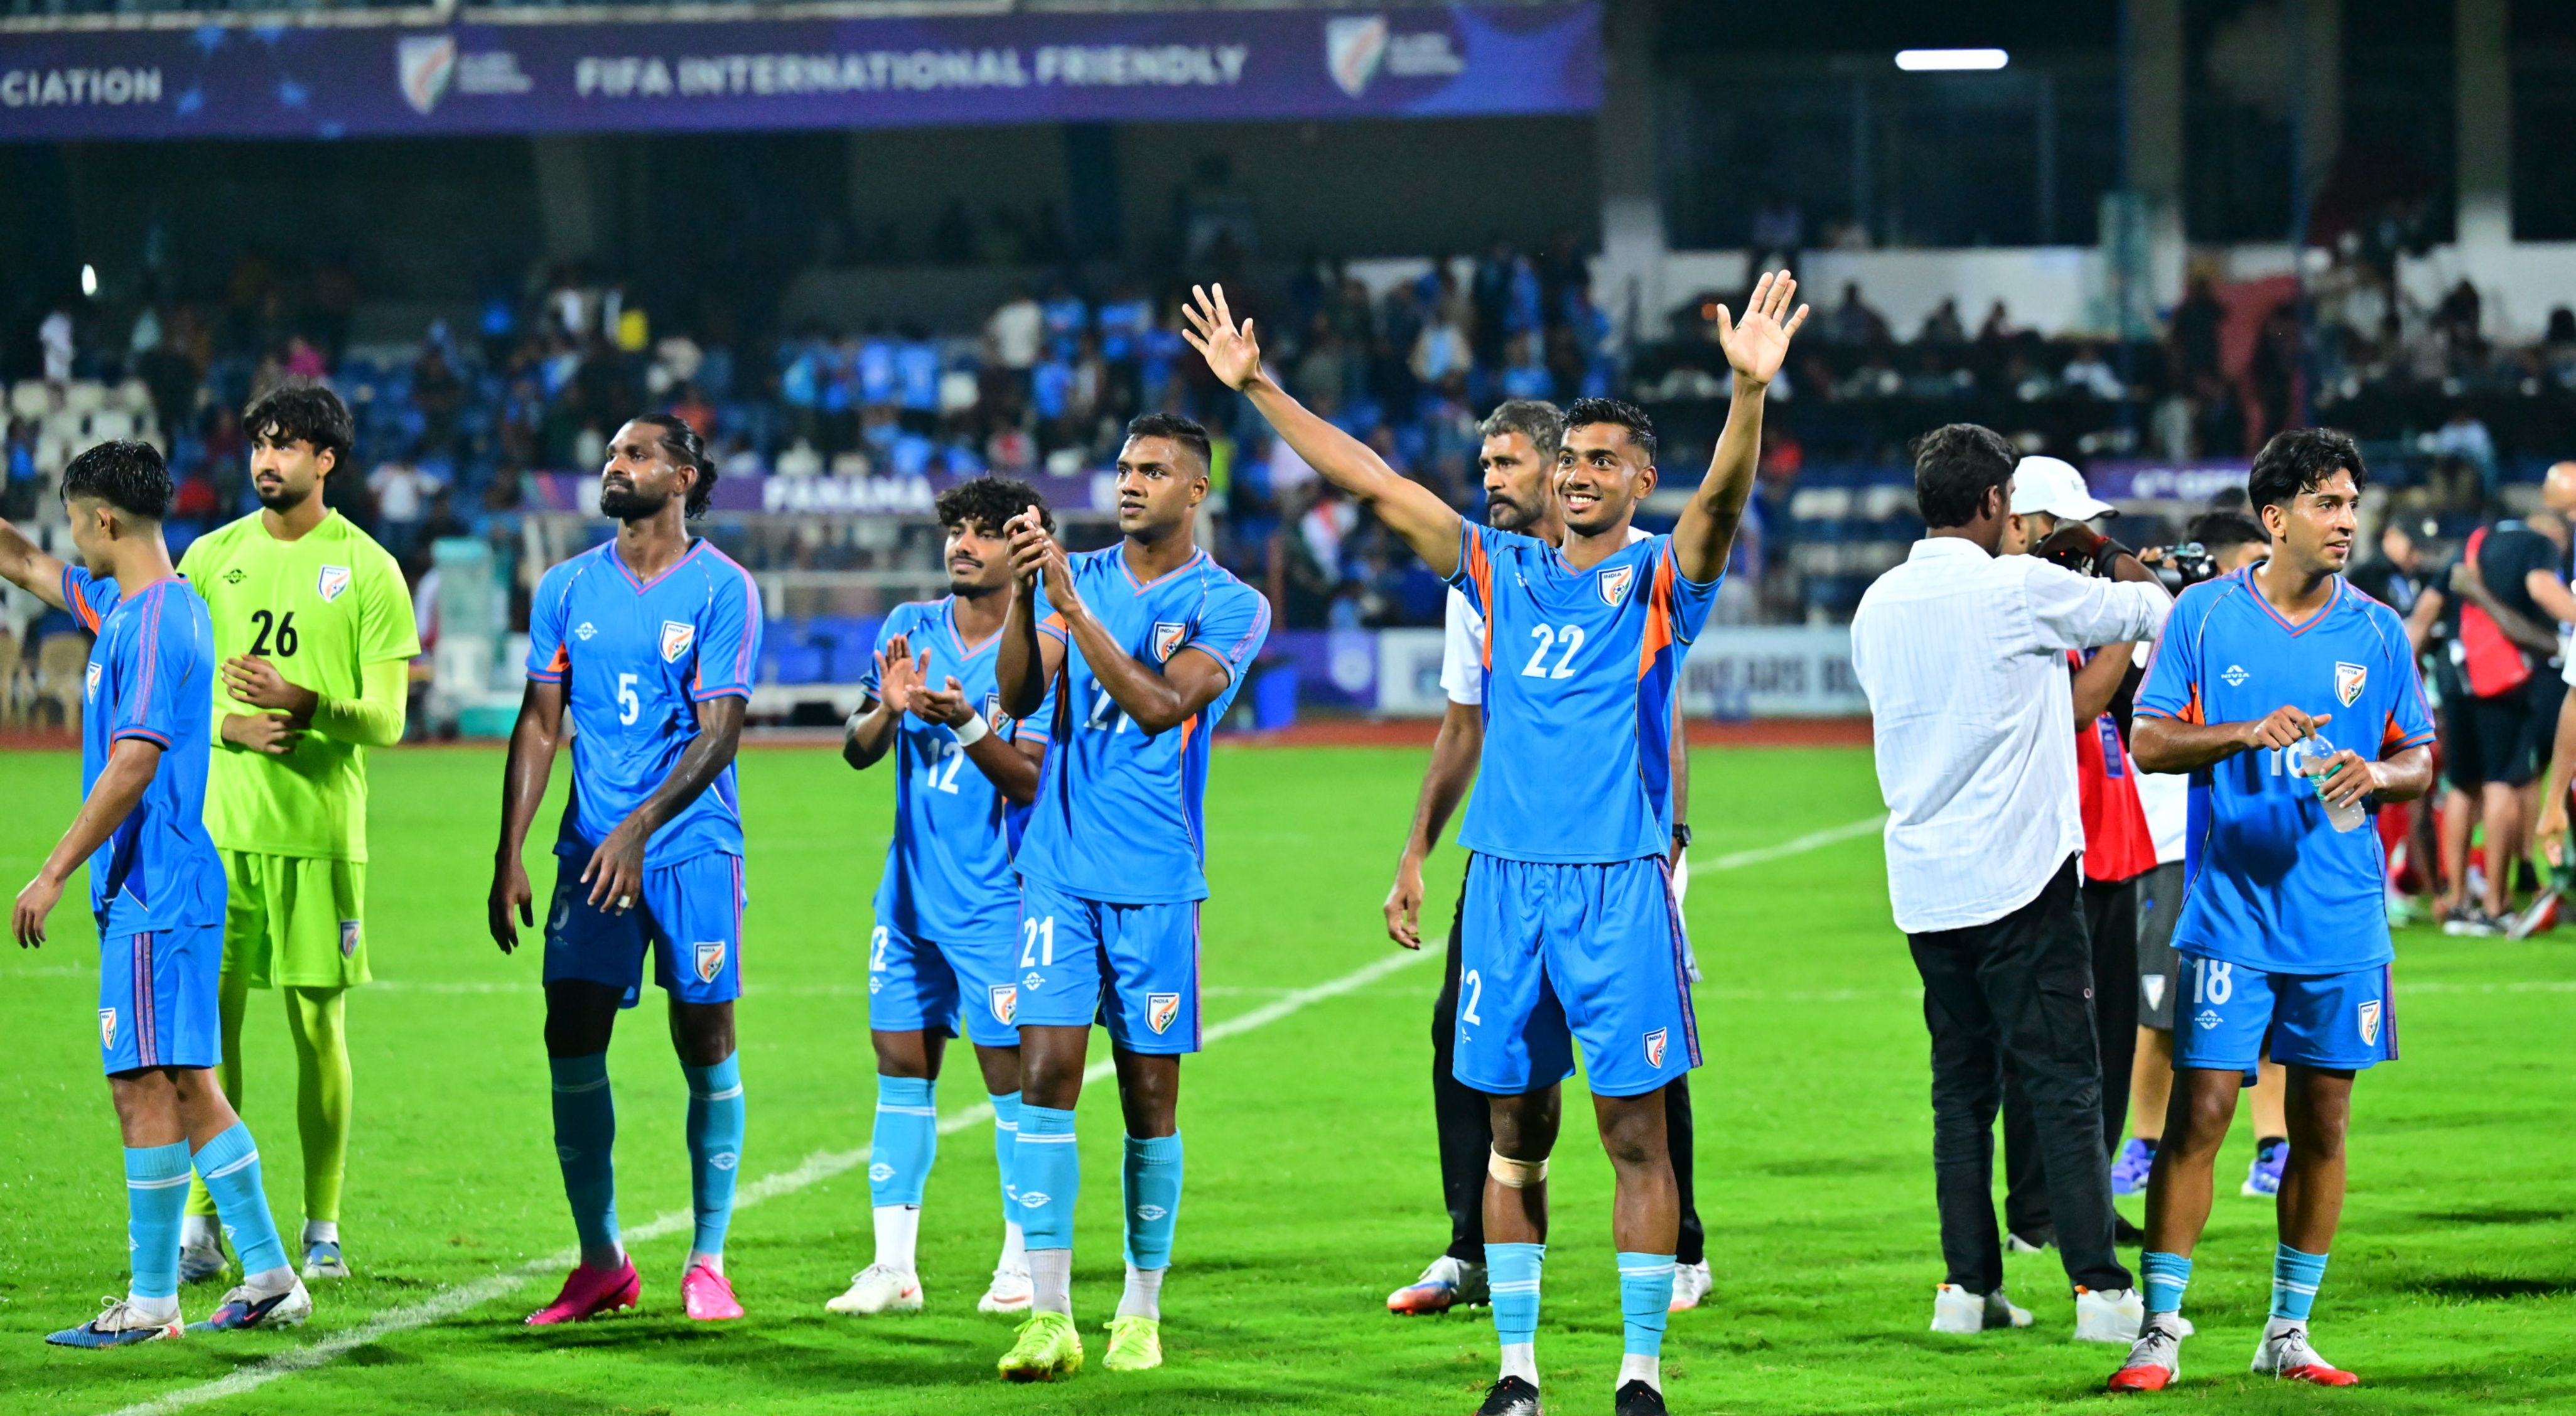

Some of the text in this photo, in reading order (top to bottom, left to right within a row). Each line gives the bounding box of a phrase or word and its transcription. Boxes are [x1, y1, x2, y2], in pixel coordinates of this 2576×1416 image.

[1, 67, 163, 107] CIATION
[575, 57, 674, 97] FIFA
[679, 48, 1028, 95] INTERNATIONAL
[1035, 44, 1249, 85] FRIENDLY
[763, 474, 934, 513] PANAMA
[249, 610, 298, 657] 26
[1521, 622, 1585, 679] 22
[618, 673, 639, 725] 5
[927, 737, 965, 795] 12
[552, 885, 572, 930] 5
[1020, 916, 1054, 968] 21
[1461, 963, 1482, 1026] 2
[2193, 958, 2232, 1005] 18
